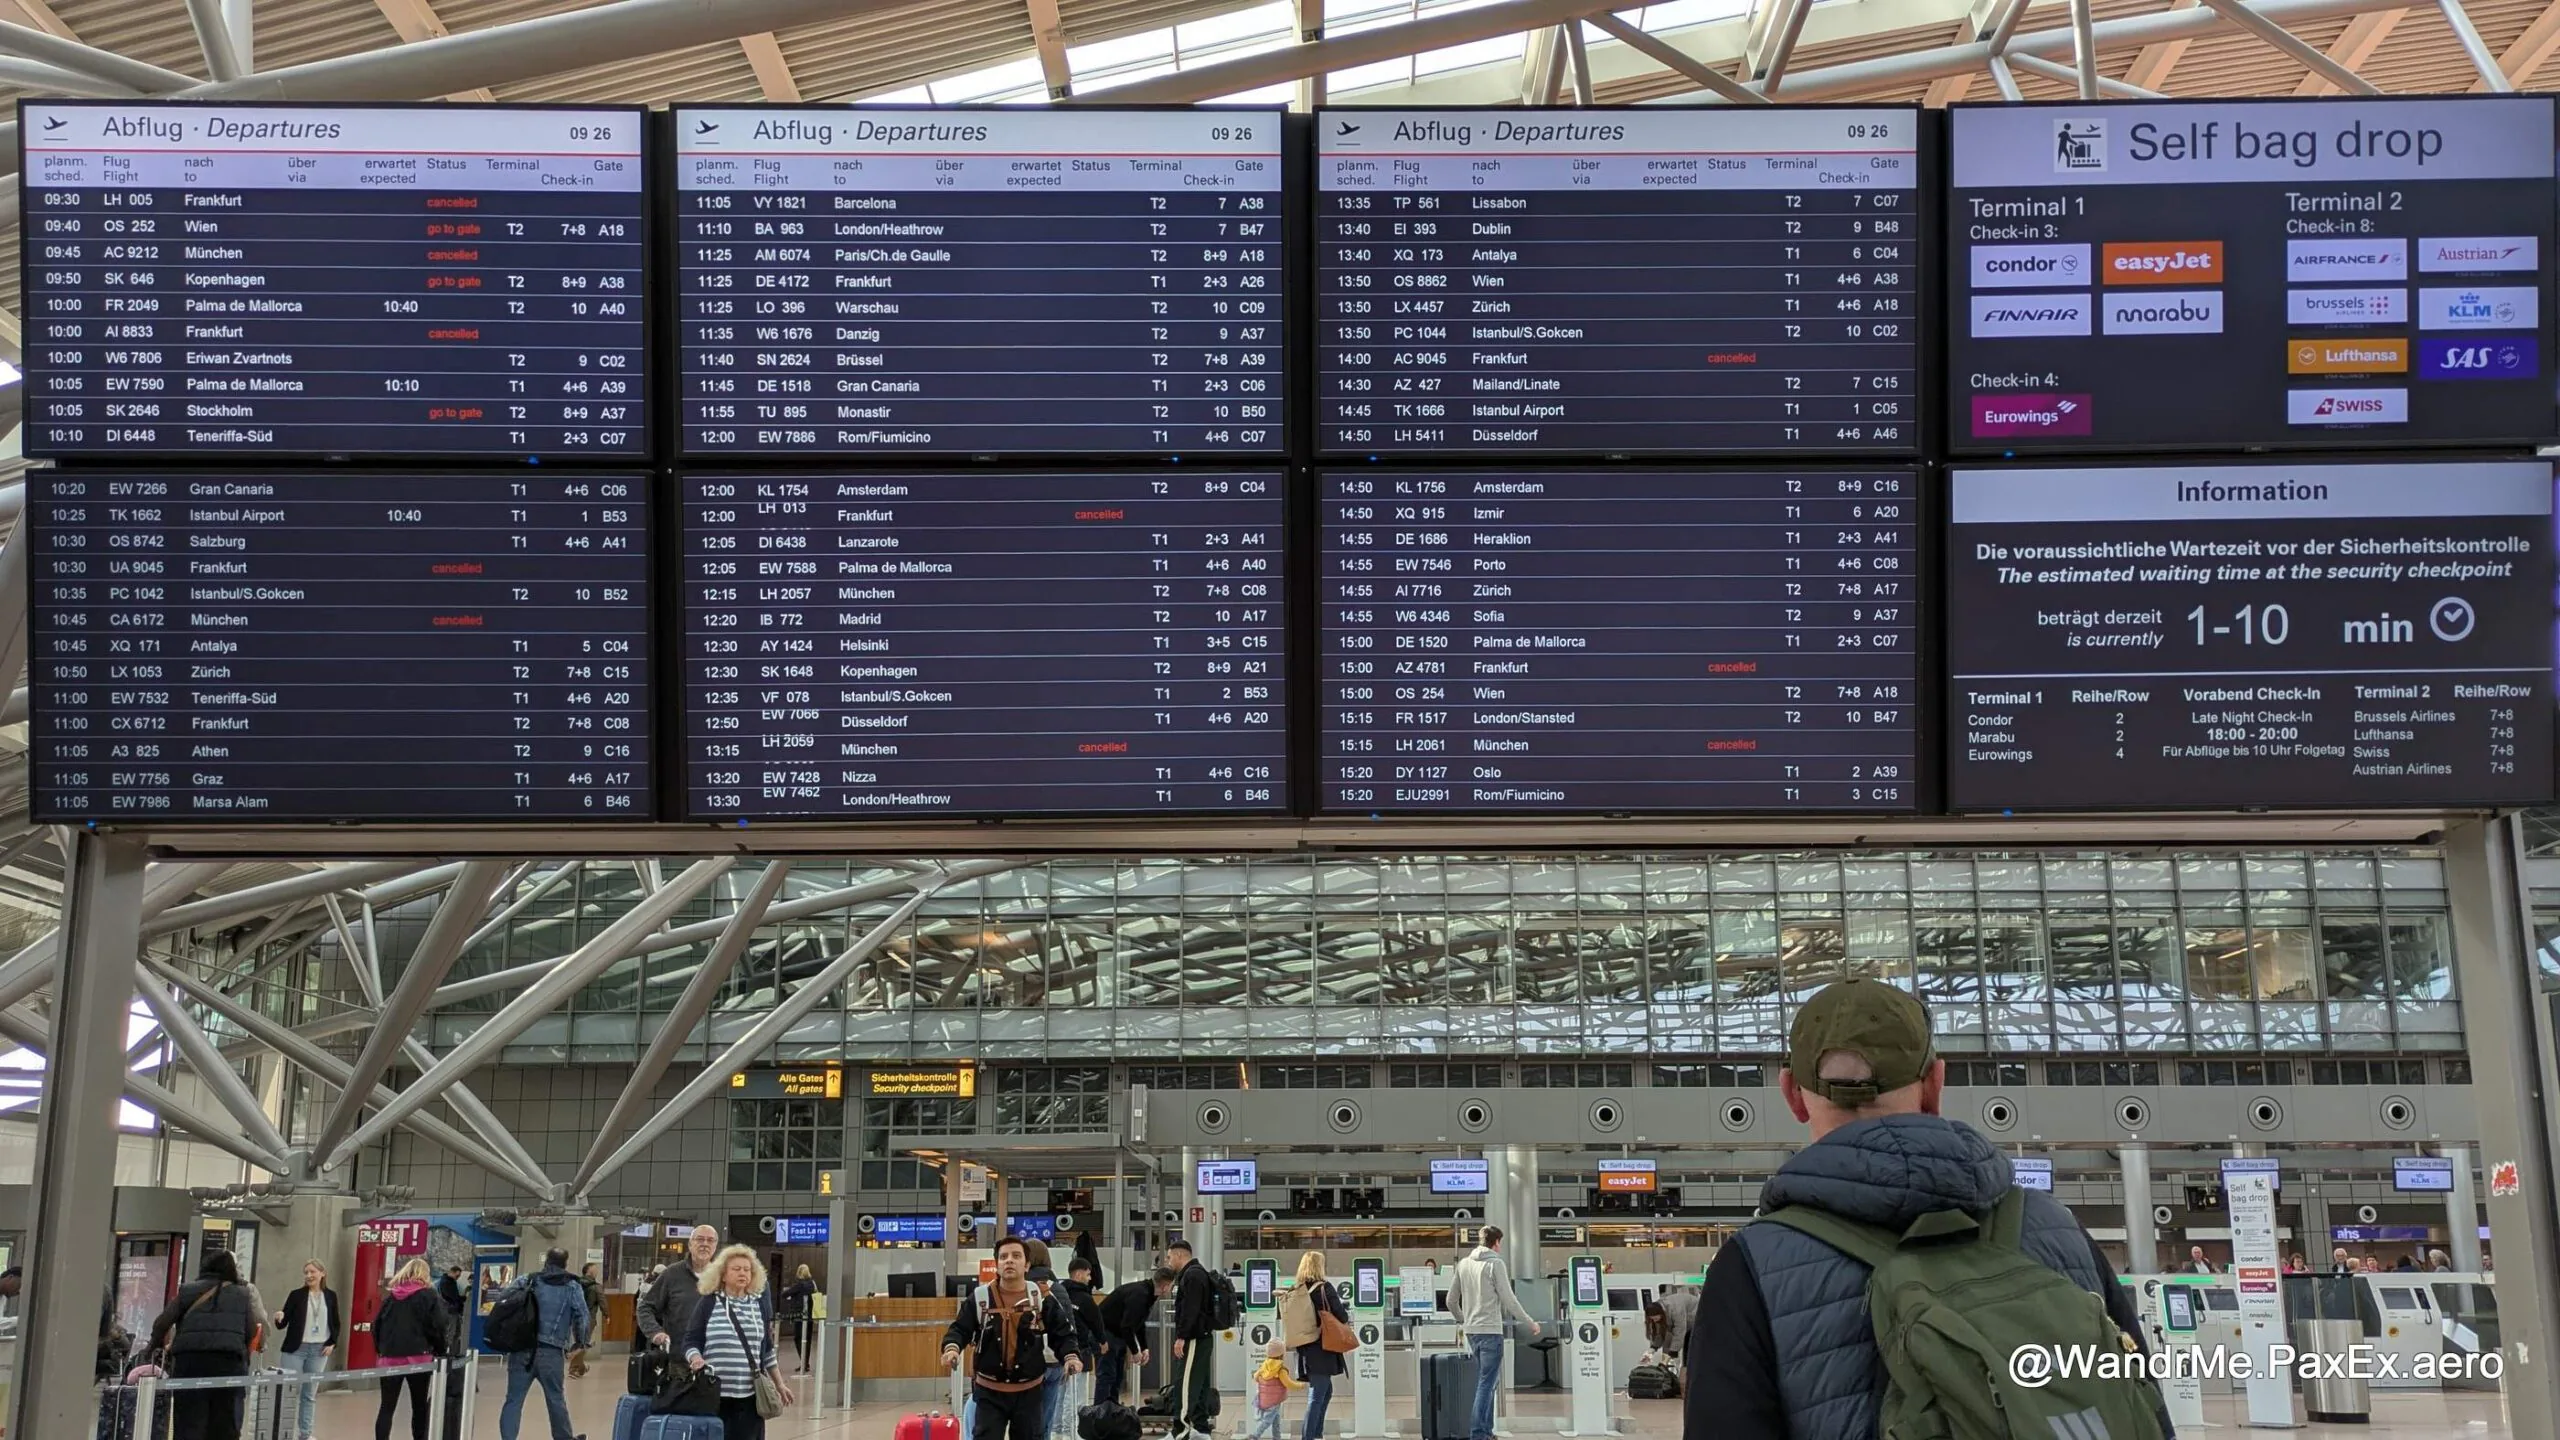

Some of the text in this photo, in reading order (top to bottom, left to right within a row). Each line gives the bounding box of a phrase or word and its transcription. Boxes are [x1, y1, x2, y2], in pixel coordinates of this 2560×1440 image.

[103, 117, 340, 142] Abflug Departures
[570, 127, 611, 140] 09 26
[754, 120, 987, 145] Abflug Departures
[1394, 121, 1624, 145] Abflug Departures
[2130, 120, 2442, 167] Self bag drop
[45, 156, 87, 168] planm.
[104, 156, 130, 169] Flug
[185, 157, 213, 167] nach
[288, 157, 316, 168] über
[365, 160, 416, 168] erwartet
[427, 158, 466, 169] Status
[486, 159, 539, 170] Terminal
[594, 160, 623, 171] Gate
[45, 170, 84, 181] sched.
[104, 171, 138, 183] Flight
[185, 173, 197, 182] to
[288, 172, 306, 182] via
[360, 173, 415, 185] expected
[541, 174, 593, 185] Check-in
[45, 193, 477, 207] 09:30 LH 005 Frankfurt cancelled
[2285, 192, 2402, 211] Terminal 2
[1969, 197, 2084, 217] Terminal 1
[698, 223, 1264, 235] 11:10 BA 963 London/Heathrow T2 7 B47
[1970, 224, 2058, 239] Check-in 3:
[2287, 219, 2374, 233] Check-in 8:
[2295, 255, 2375, 264] AIRFRANCE
[2437, 248, 2498, 260] Austrian
[1986, 256, 2057, 272] condor
[2115, 252, 2211, 272] easyJet
[1338, 273, 1898, 287] 13:50 OS 8862 Wien T1 4+6 A38
[2306, 297, 2364, 309] brussels
[1984, 309, 2078, 321] FINNAIR
[2117, 299, 2209, 322] marabu
[2449, 305, 2491, 317] KLM
[2326, 349, 2397, 362] Lufthansa
[2441, 348, 2492, 368] SAS
[1971, 373, 2058, 387] Check-in 4:
[2337, 400, 2382, 412] SWISS
[1986, 410, 2058, 425] Eurowings
[2178, 480, 2327, 501] Information
[52, 509, 421, 523] 10:25 TK 1662 Istanbul Airport 10:40
[1977, 536, 2529, 559] Die voraussichtliche Wartezeit vor der Sicherheitskontrolle
[1998, 561, 2512, 584] The estimated waiting time at the security checkpoint
[704, 610, 1267, 626] 12:20 IB 772 Madrid T2 10 A17
[2038, 609, 2162, 628] beträgt derzeit
[2188, 604, 2288, 645] 1-10
[2345, 613, 2413, 643] min
[2067, 631, 2163, 648] is currently
[2072, 690, 2149, 702] Reihe/Row
[2184, 687, 2320, 701] Vorabend Check-In
[2355, 685, 2430, 698] Terminal 2
[2455, 685, 2531, 697] Reihe/Row
[1968, 692, 2042, 704] Terminal 1
[1968, 714, 2013, 725] Condor
[2192, 711, 2312, 725] Late Night Check-In
[2355, 710, 2455, 722] Brussels Airlines
[1969, 732, 2014, 743] Marabu
[2207, 728, 2297, 740] 18:00 20:00
[2354, 729, 2413, 740] Lufthansa
[1341, 739, 1756, 750] 15:15 LH 2061 München cancelled
[1969, 749, 2032, 762] Eurowings
[2163, 744, 2345, 759] Für Abflüge bis 10 Uhr Folgetag
[2354, 747, 2389, 757] Swiss
[779, 1074, 823, 1082] Alle Gates
[872, 1073, 957, 1082] Sicherheitskontrolle
[799, 1086, 823, 1094] gates
[873, 1084, 957, 1093] Security checkpoint
[1609, 1177, 1646, 1186] easyJet
[2230, 1184, 2245, 1192] Self
[2231, 1194, 2268, 1203] bag drop
[2337, 1229, 2359, 1239] ahs
[1342, 1287, 1350, 1299] 2
[1257, 1331, 1264, 1342] 1
[1365, 1330, 1372, 1342] 1
[1584, 1330, 1591, 1341] 1
